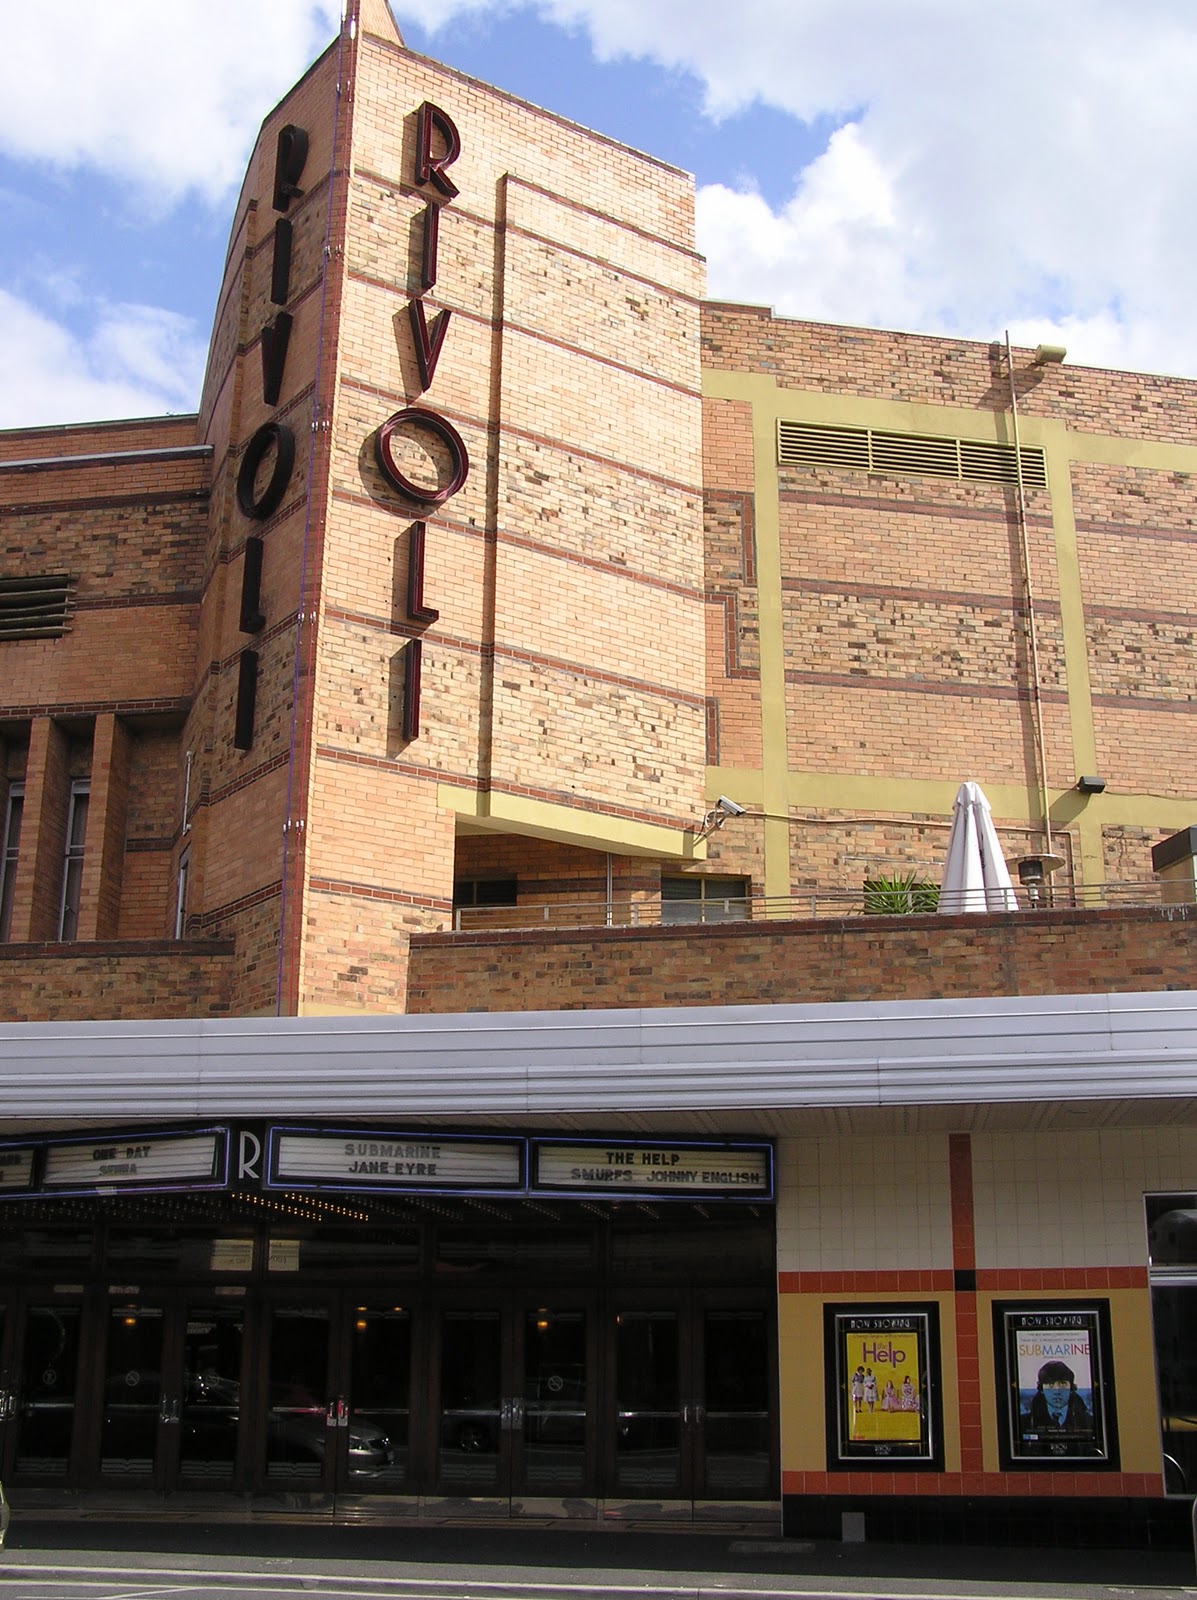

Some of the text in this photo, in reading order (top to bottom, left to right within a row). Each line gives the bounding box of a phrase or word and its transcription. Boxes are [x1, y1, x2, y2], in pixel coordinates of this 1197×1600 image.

[374, 101, 469, 742] RIVOLI
[236, 123, 309, 751] RIVOLI
[238, 1131, 261, 1179] R
[344, 1143, 441, 1159] SUBMARINE
[606, 1152, 680, 1166] THE HELP
[349, 1161, 437, 1176] JANE EYRE
[647, 1170, 698, 1183] JOHNNY
[702, 1172, 760, 1184] ENGLISH
[850, 1318, 910, 1329] NOW SHOWING
[1021, 1315, 1082, 1326] NOW SHOWING
[863, 1341, 906, 1368] Help
[1019, 1343, 1090, 1356] SUBMARINE
